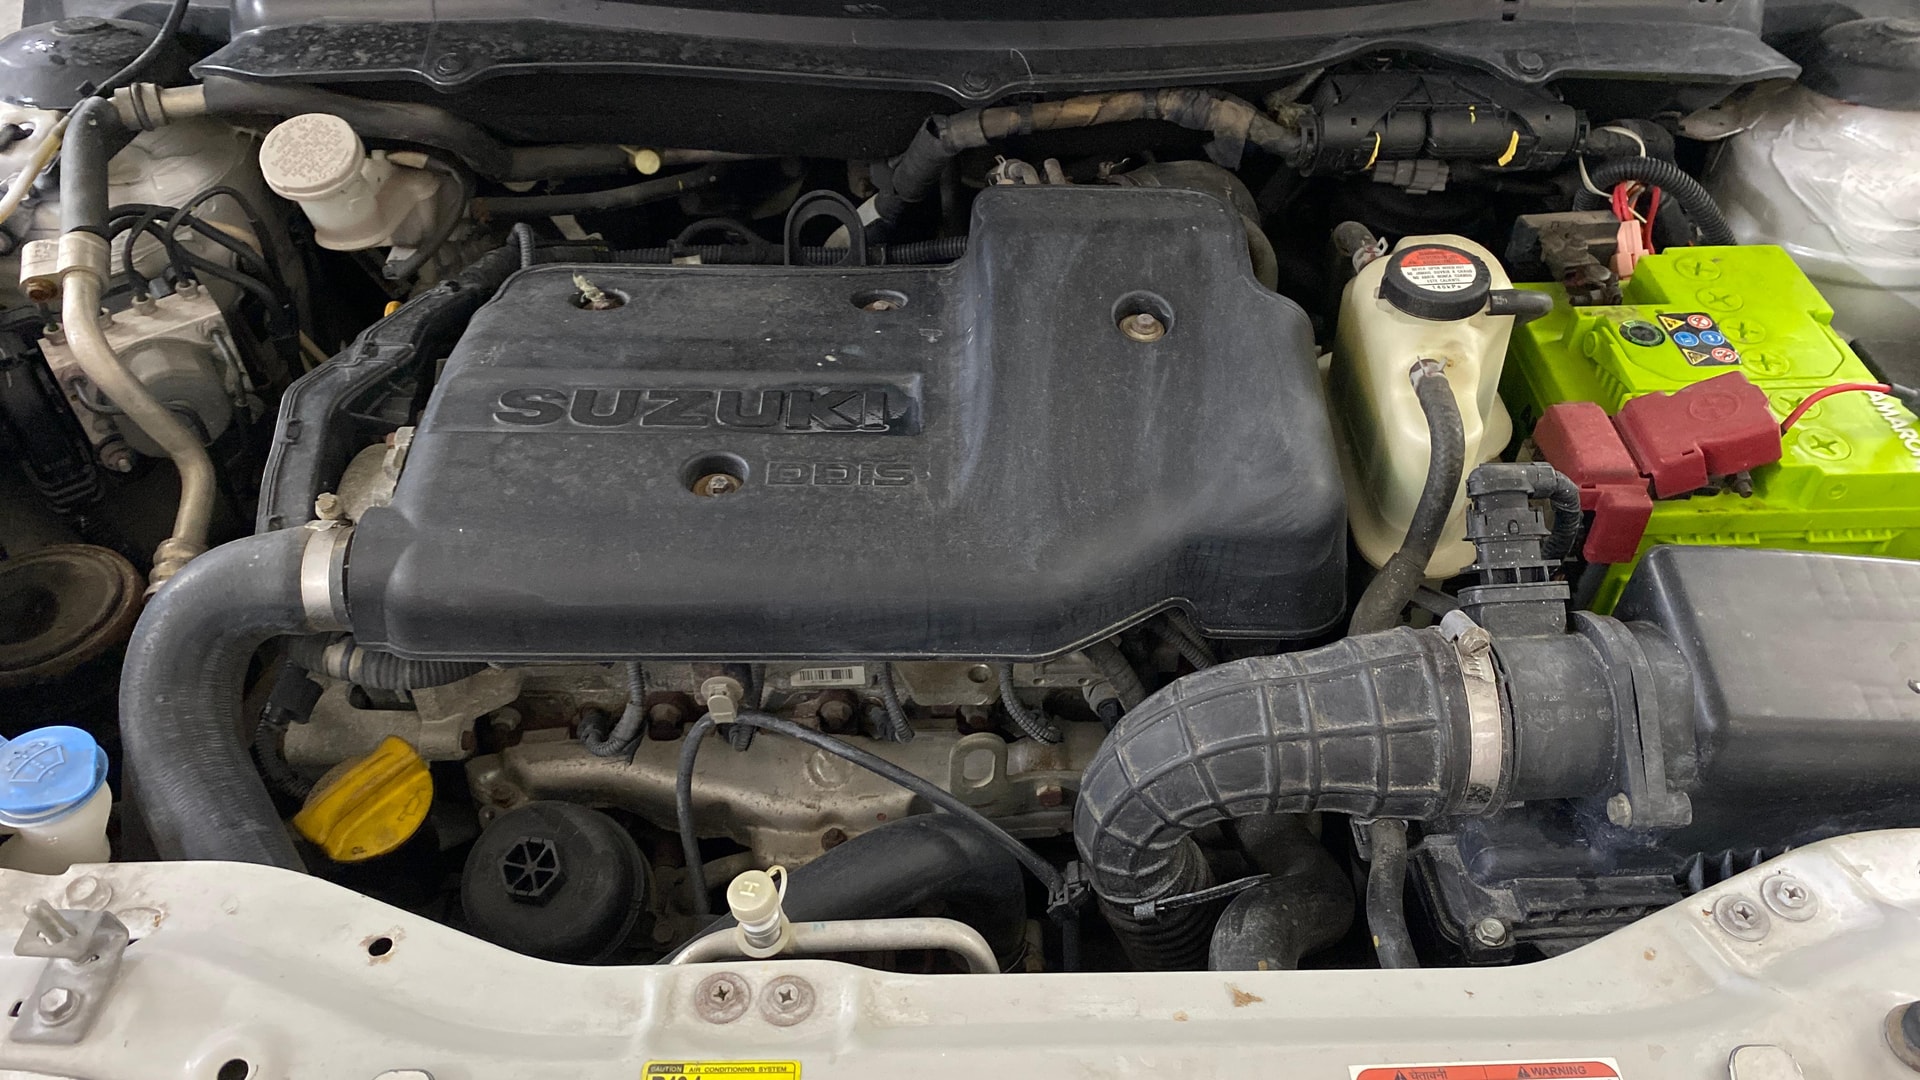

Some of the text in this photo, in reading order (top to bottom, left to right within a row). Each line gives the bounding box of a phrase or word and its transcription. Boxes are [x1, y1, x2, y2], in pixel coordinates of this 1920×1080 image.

[492, 387, 889, 434] SUZUKI
[739, 881, 760, 897] H
[650, 1065, 683, 1073] CAUTION
[1530, 1065, 1587, 1076] WARNING
